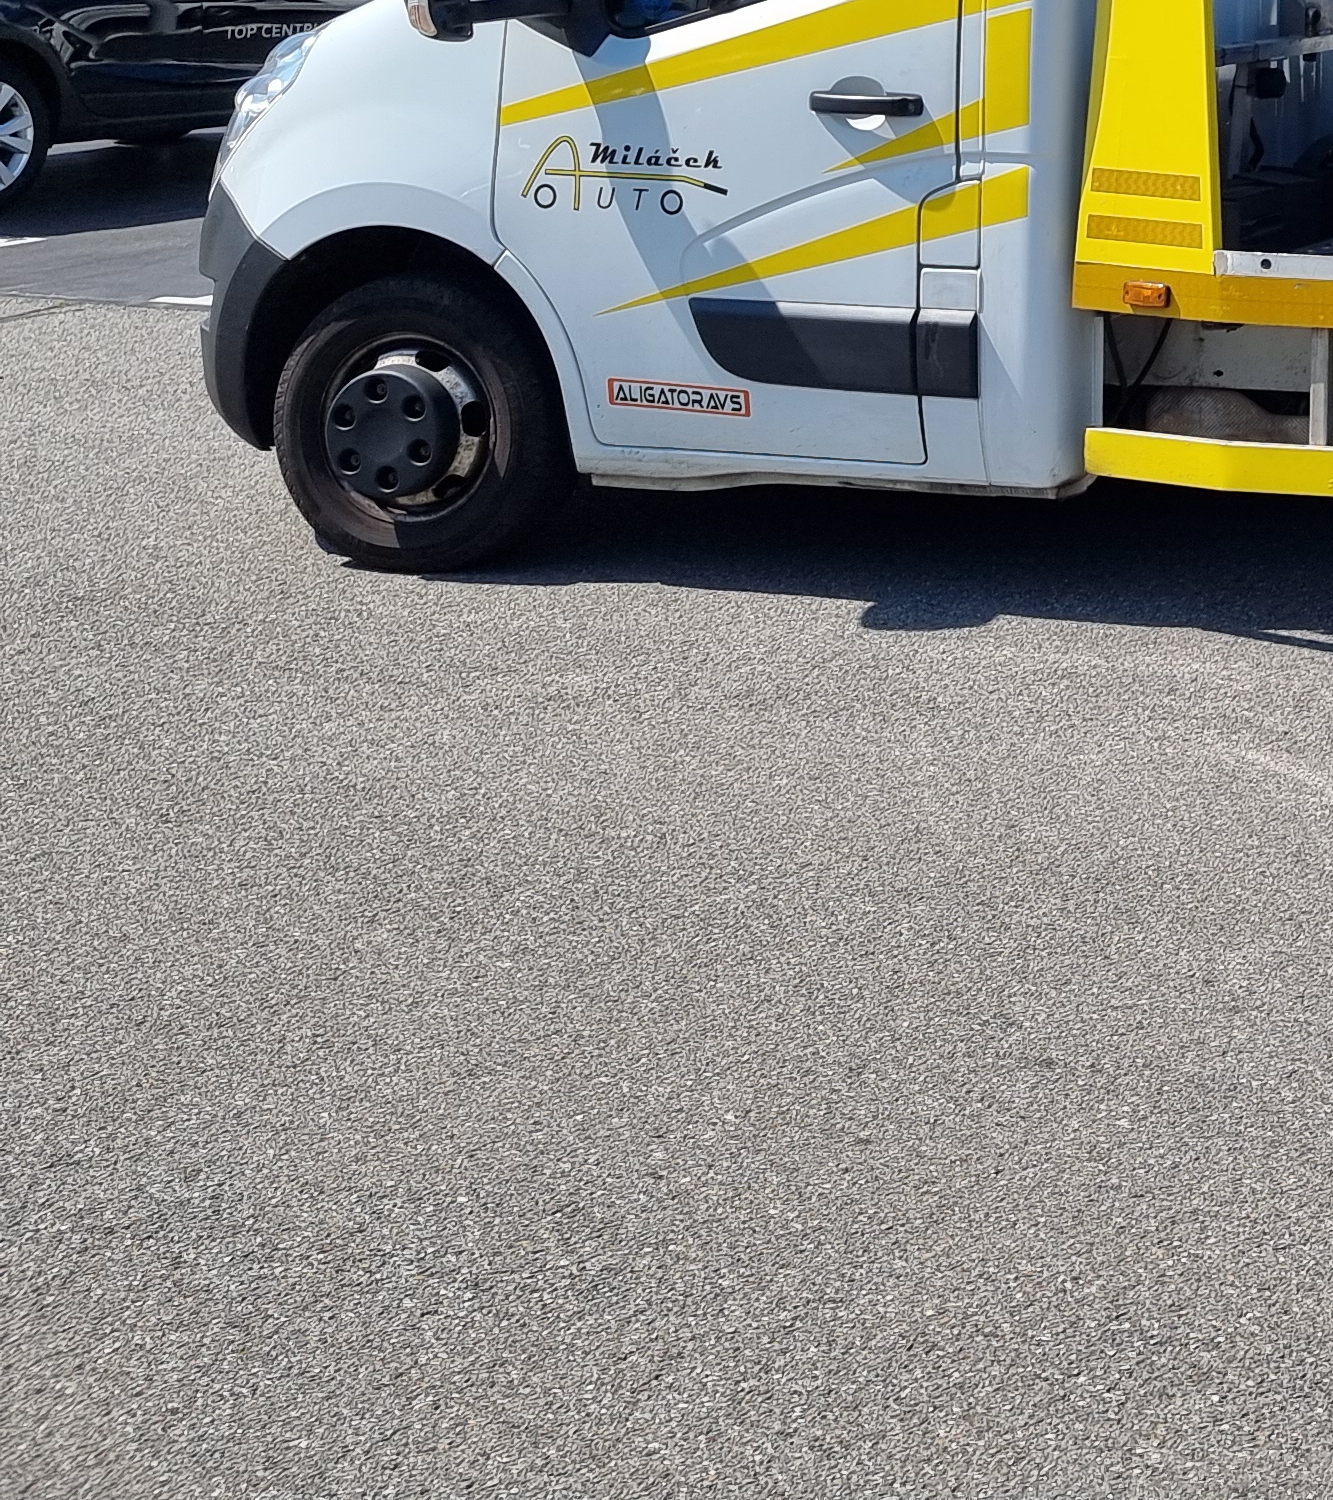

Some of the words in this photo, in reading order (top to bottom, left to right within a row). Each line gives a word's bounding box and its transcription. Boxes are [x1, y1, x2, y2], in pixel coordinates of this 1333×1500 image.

[227, 24, 257, 39] TOP
[262, 23, 317, 37] CENTR
[589, 141, 722, 169] Miláček
